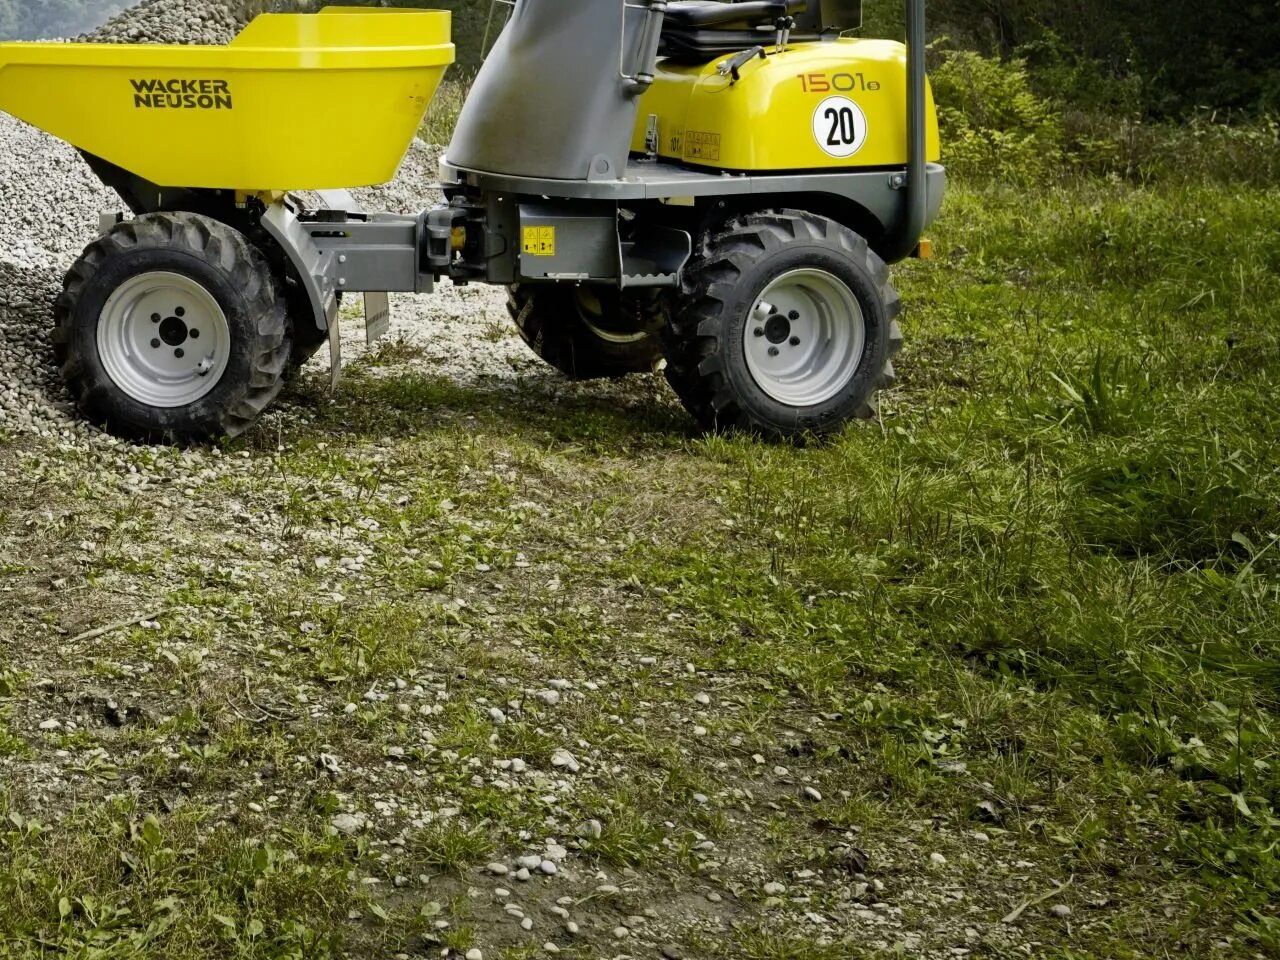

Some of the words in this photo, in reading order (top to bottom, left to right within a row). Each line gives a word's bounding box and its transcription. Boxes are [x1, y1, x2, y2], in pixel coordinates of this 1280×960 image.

[128, 79, 231, 94] WACKER
[133, 93, 233, 110] NEUSON
[824, 106, 855, 146] 20
